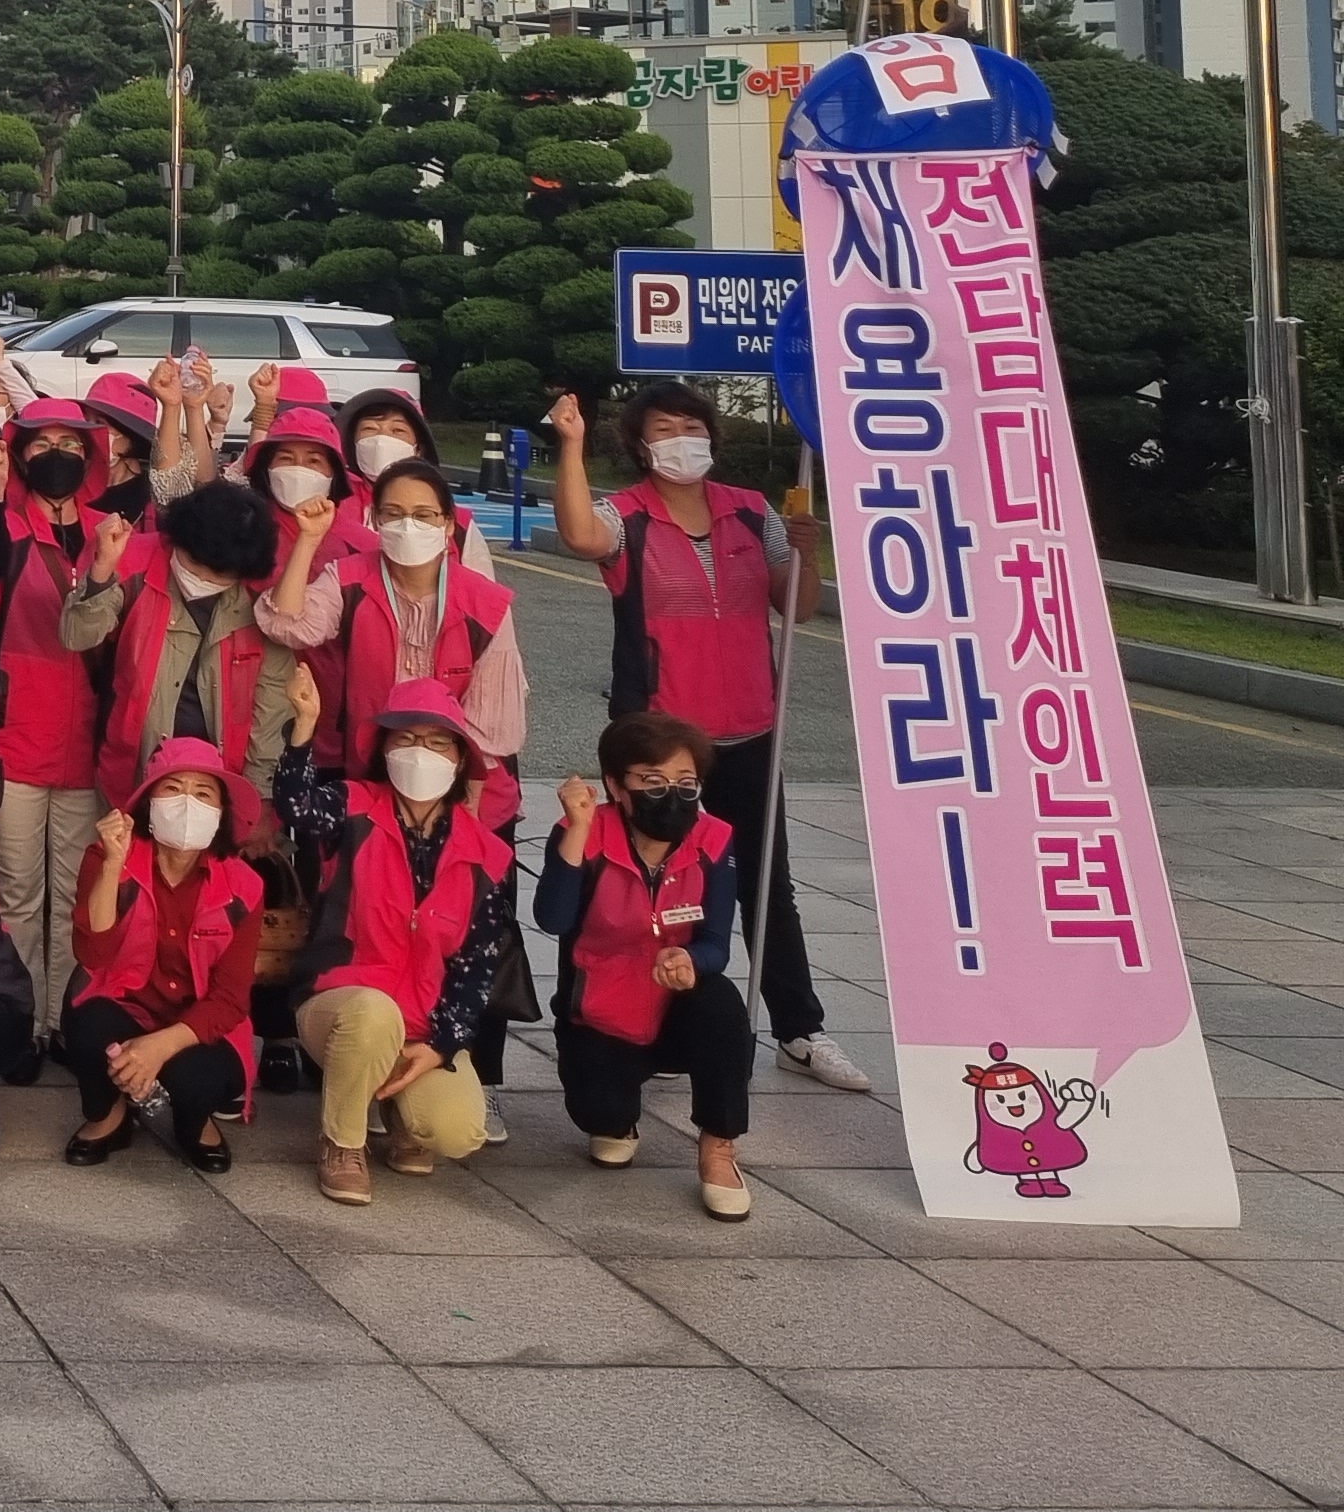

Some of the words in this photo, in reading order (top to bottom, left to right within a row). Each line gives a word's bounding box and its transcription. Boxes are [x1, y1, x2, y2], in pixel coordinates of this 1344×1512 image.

[698, 276, 757, 325] 민원인
[814, 160, 998, 970] 채용하라!
[920, 161, 1144, 967] 전담대체인력
